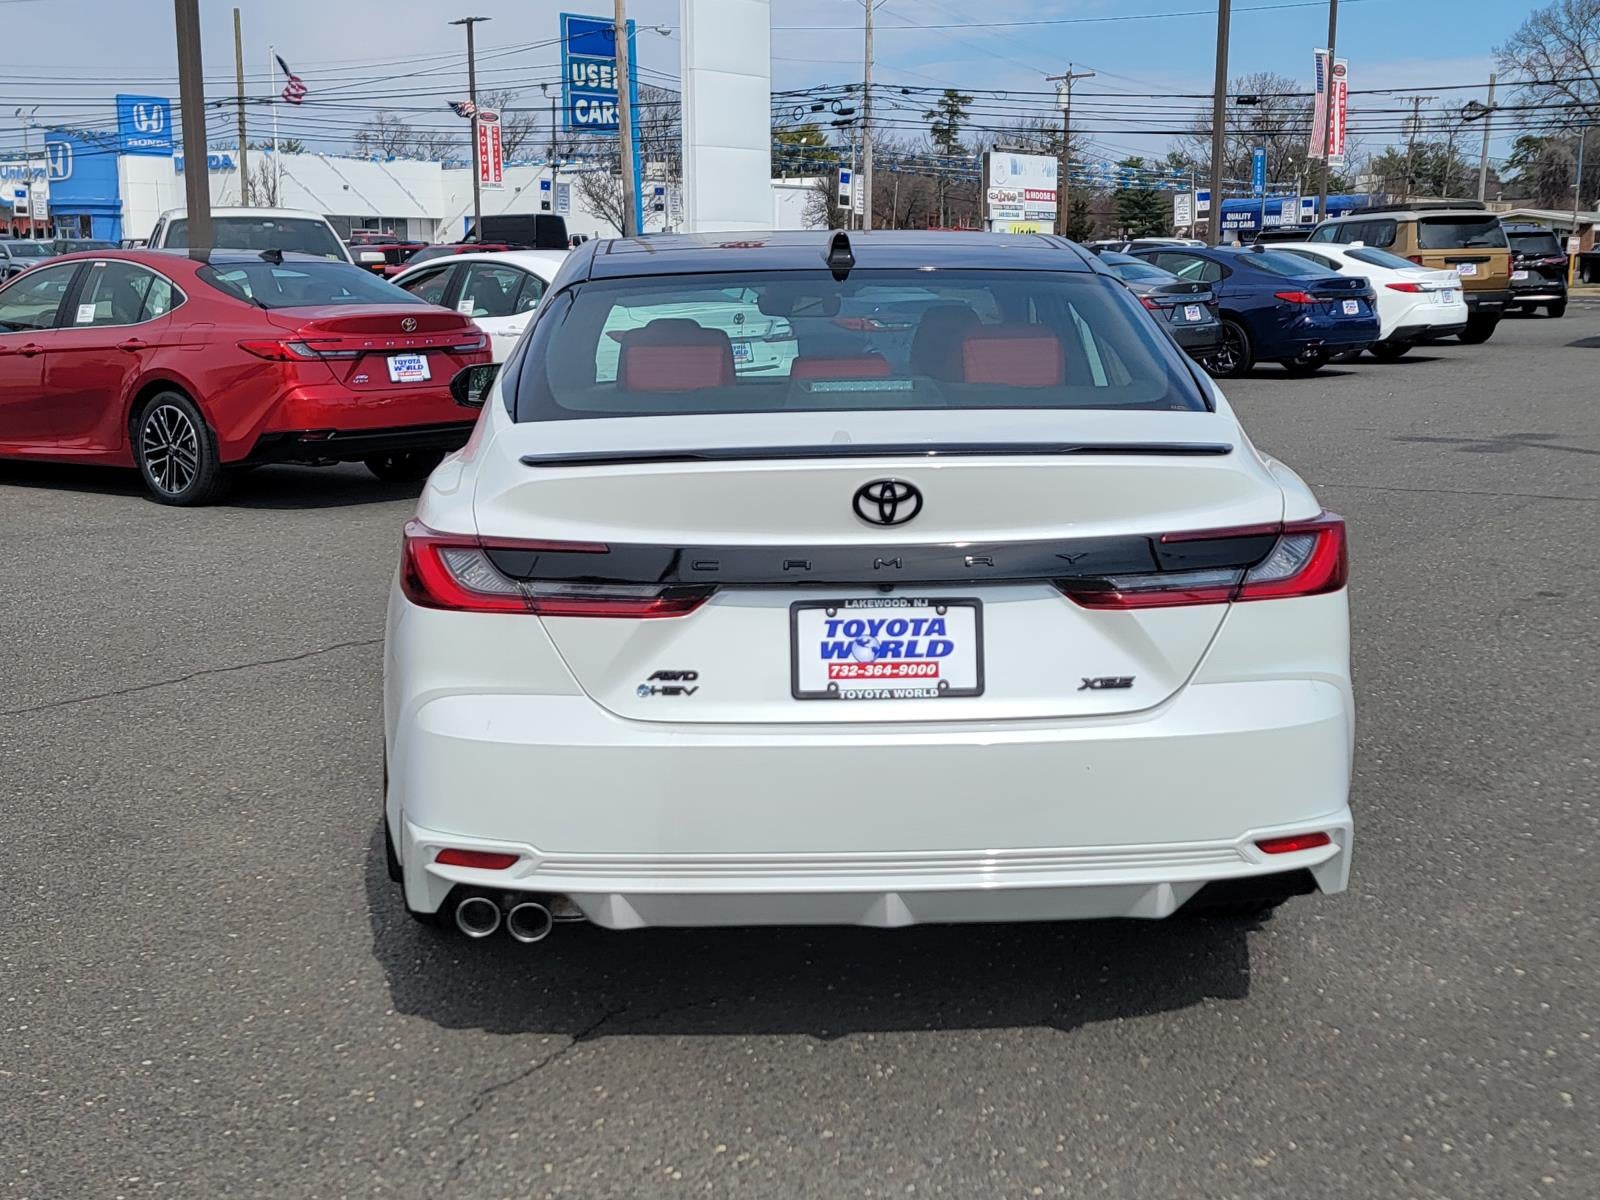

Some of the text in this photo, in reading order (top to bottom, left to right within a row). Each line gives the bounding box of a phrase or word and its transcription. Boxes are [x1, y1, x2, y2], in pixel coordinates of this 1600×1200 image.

[480, 126, 489, 180] TOYOTA
[492, 127, 500, 181] CERTIFIED
[1221, 220, 1255, 229] USED CARS
[691, 551, 1088, 572] CAMRY
[913, 599, 929, 608] NJ
[824, 618, 947, 638] TOYOTA
[821, 638, 954, 661] WORLD
[646, 670, 699, 681] AWD
[830, 664, 937, 677] 732-364-9000
[839, 688, 939, 699] TOYOTA WORLD
